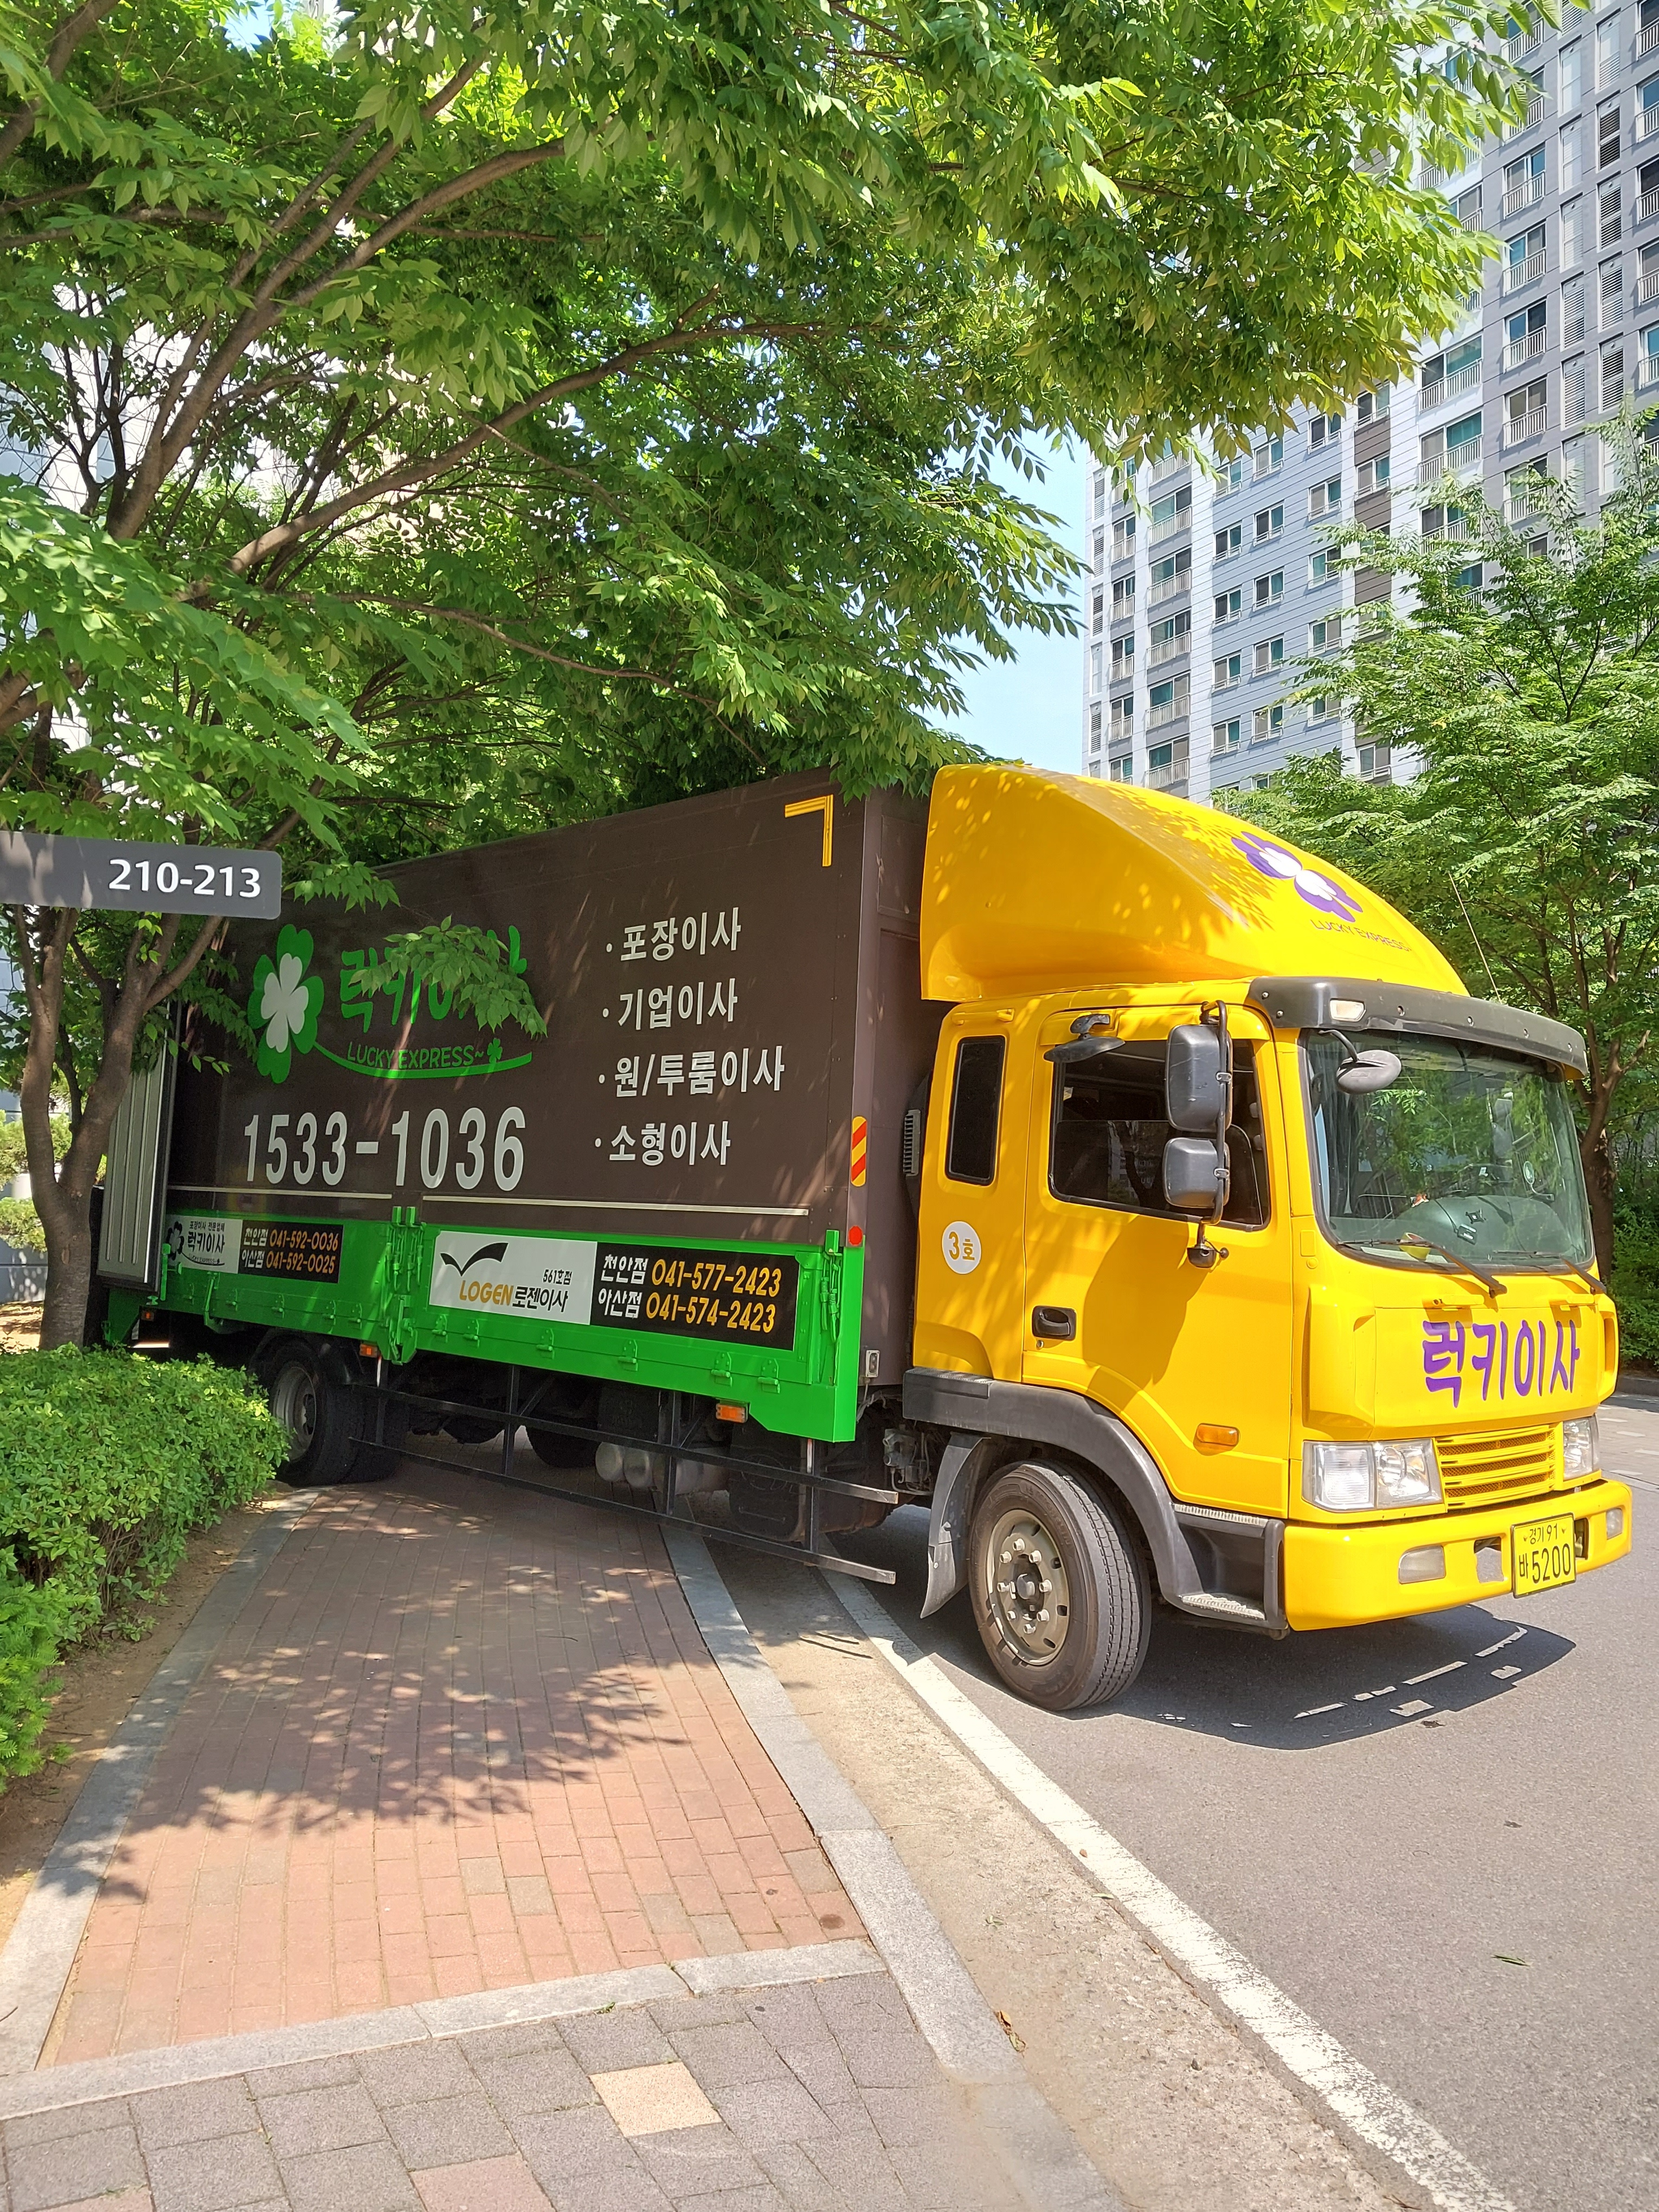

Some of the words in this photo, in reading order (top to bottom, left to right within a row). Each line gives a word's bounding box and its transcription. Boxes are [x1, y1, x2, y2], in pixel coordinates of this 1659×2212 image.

[108, 858, 262, 898] 210-213
[620, 906, 742, 962] 포장이사
[1310, 919, 1355, 935] LUCKY
[618, 978, 738, 1030] 기업이사
[346, 1041, 395, 1068] LUCKY
[614, 1045, 785, 1098] 원/투룸이사
[244, 1106, 526, 1191] 1533-1036
[609, 1121, 731, 1166] 소형이사
[187, 1231, 226, 1253] 럭키이사
[243, 1227, 269, 1247] 천안점
[269, 1229, 339, 1251] 041-592-0036
[948, 1231, 975, 1261] 3호
[241, 1249, 265, 1269] 아산점
[266, 1250, 336, 1274] 041-592-0025
[543, 1269, 573, 1285] 561호점
[601, 1254, 649, 1284] 천안점
[652, 1259, 782, 1297] 041-577-2423
[598, 1288, 642, 1319] 아산점
[646, 1292, 776, 1333] 041-574-2423
[1423, 1319, 1580, 1409] 럭키이사
